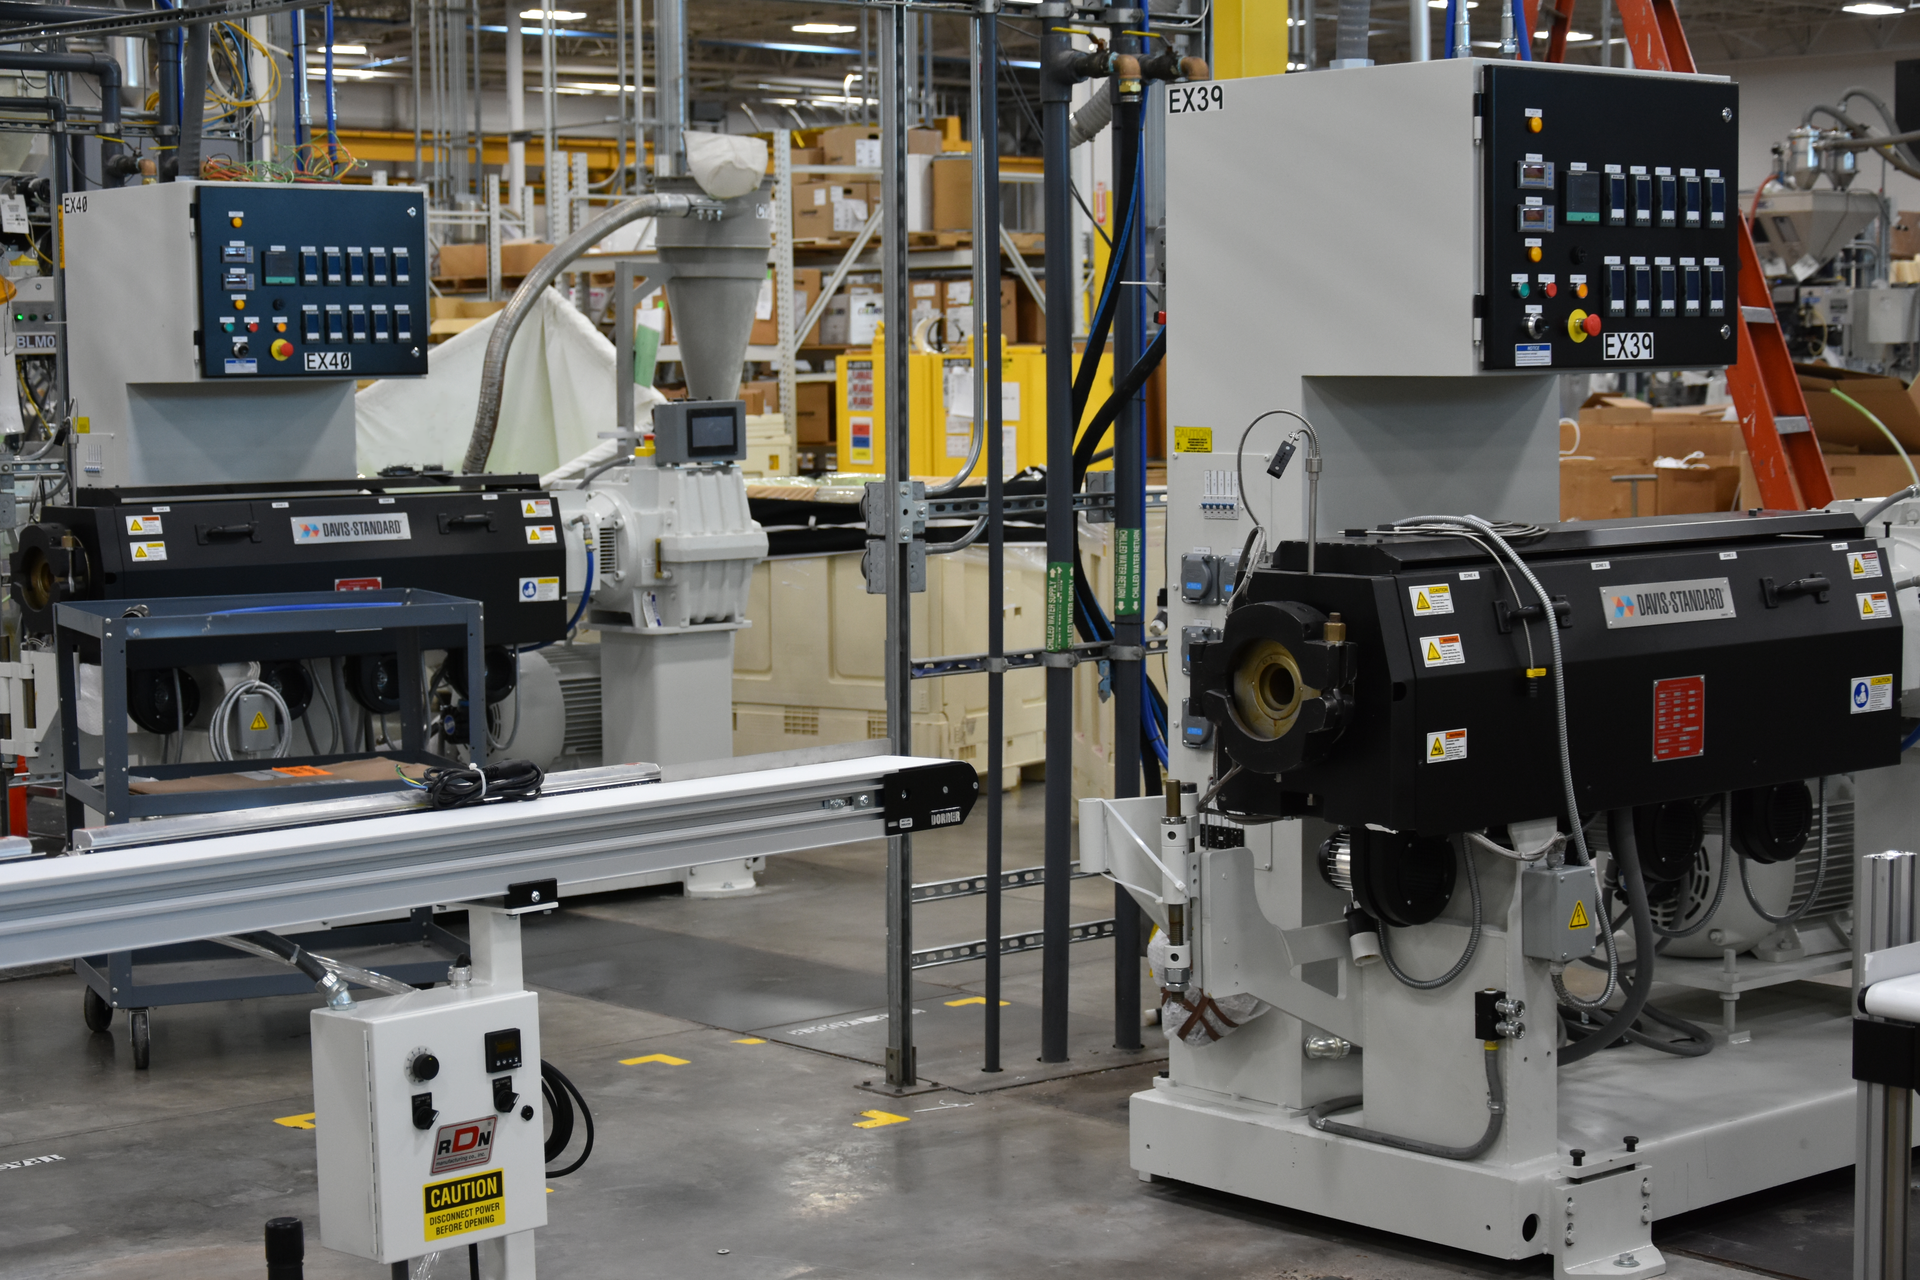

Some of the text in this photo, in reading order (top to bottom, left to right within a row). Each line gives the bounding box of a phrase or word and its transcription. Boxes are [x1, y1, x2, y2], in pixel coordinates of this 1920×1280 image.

[1169, 85, 1222, 113] EX39
[65, 196, 88, 214] EX40
[1605, 333, 1652, 359] EX39
[307, 353, 350, 369] EX40
[1118, 530, 1128, 598] CHILLED WATER RETURN
[1132, 554, 1140, 573] WATER
[438, 1126, 491, 1155] RDN
[436, 1155, 468, 1166] manufacturing
[430, 1176, 497, 1208] CAUTION
[429, 1202, 500, 1226] DISCONNECT POWER
[436, 1214, 495, 1236] BEFORE OPENING
